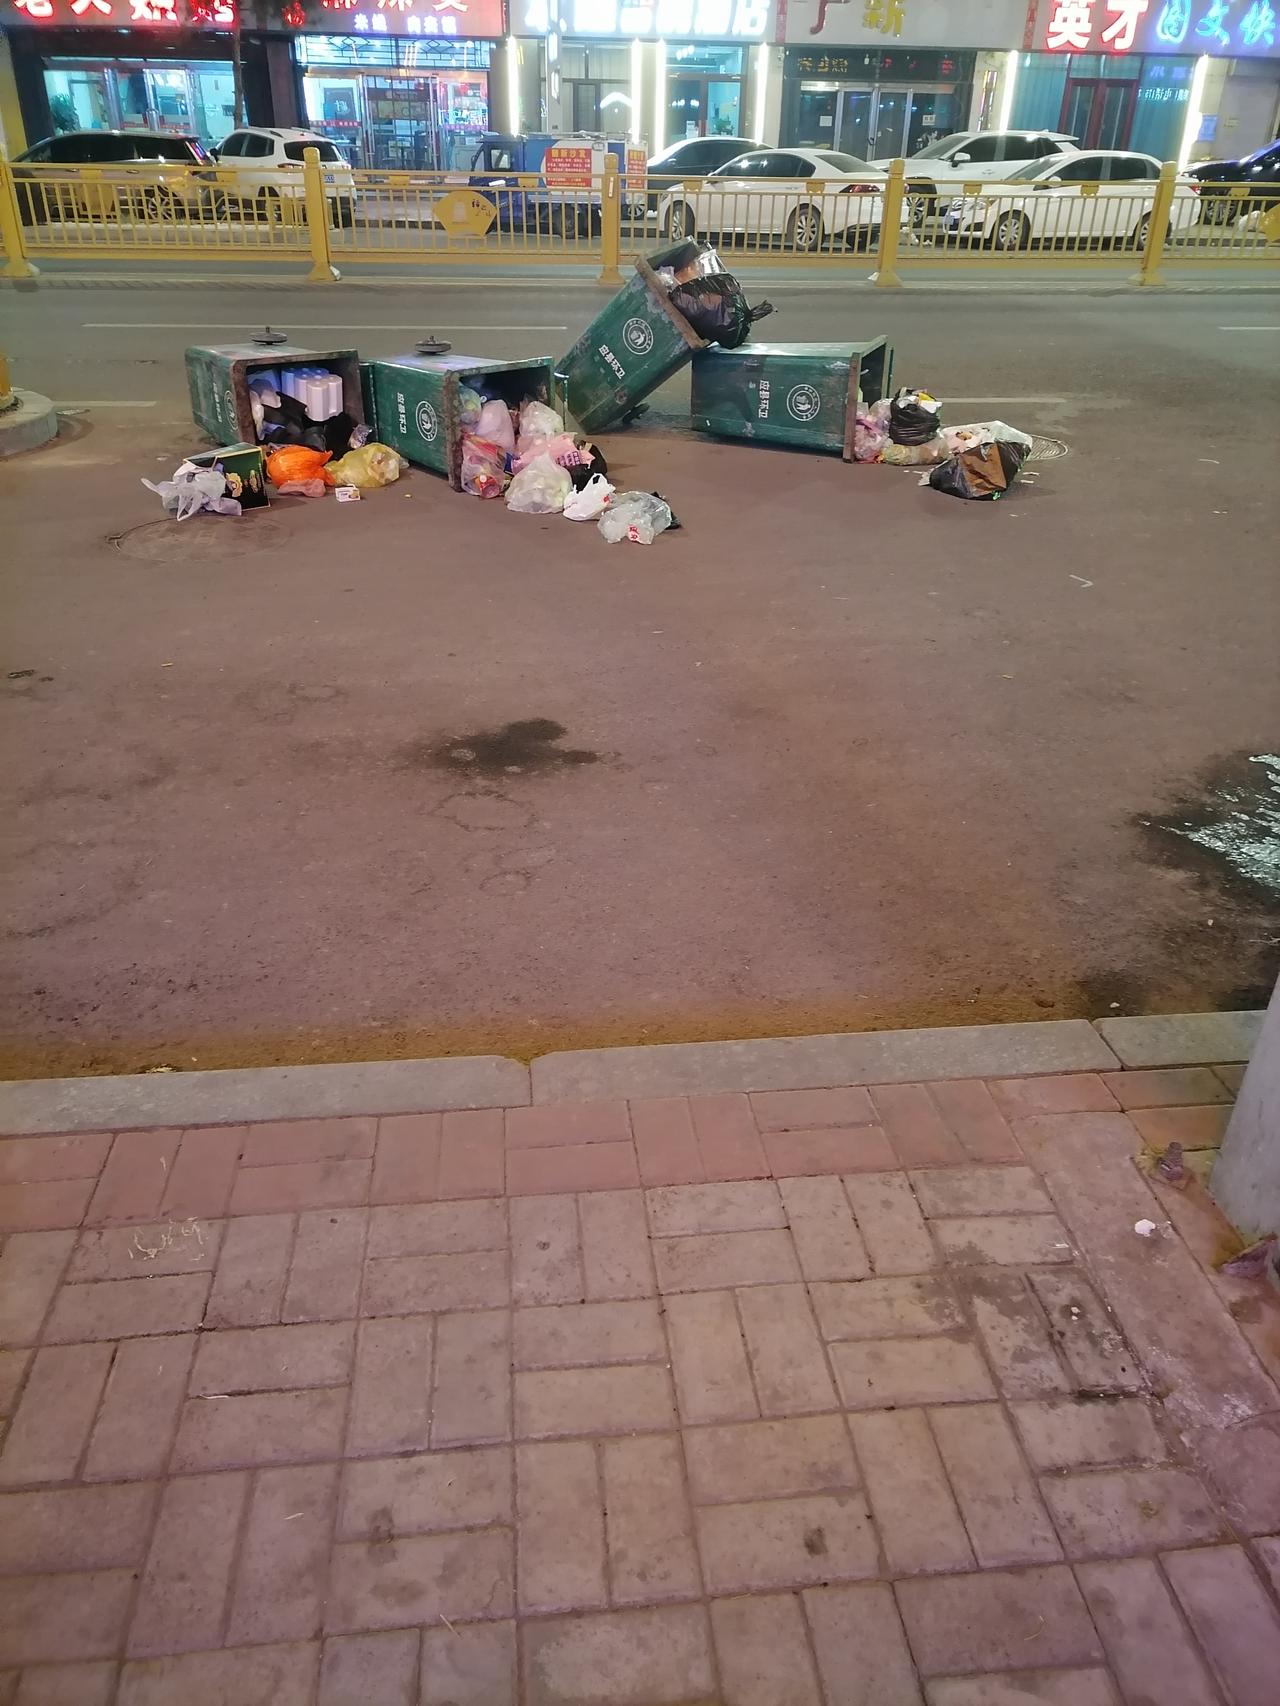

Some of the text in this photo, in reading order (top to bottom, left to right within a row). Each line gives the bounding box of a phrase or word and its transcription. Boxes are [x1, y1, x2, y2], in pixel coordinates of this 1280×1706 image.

[598, 344, 626, 379] 应县环卫
[758, 380, 770, 419] 应县环卫
